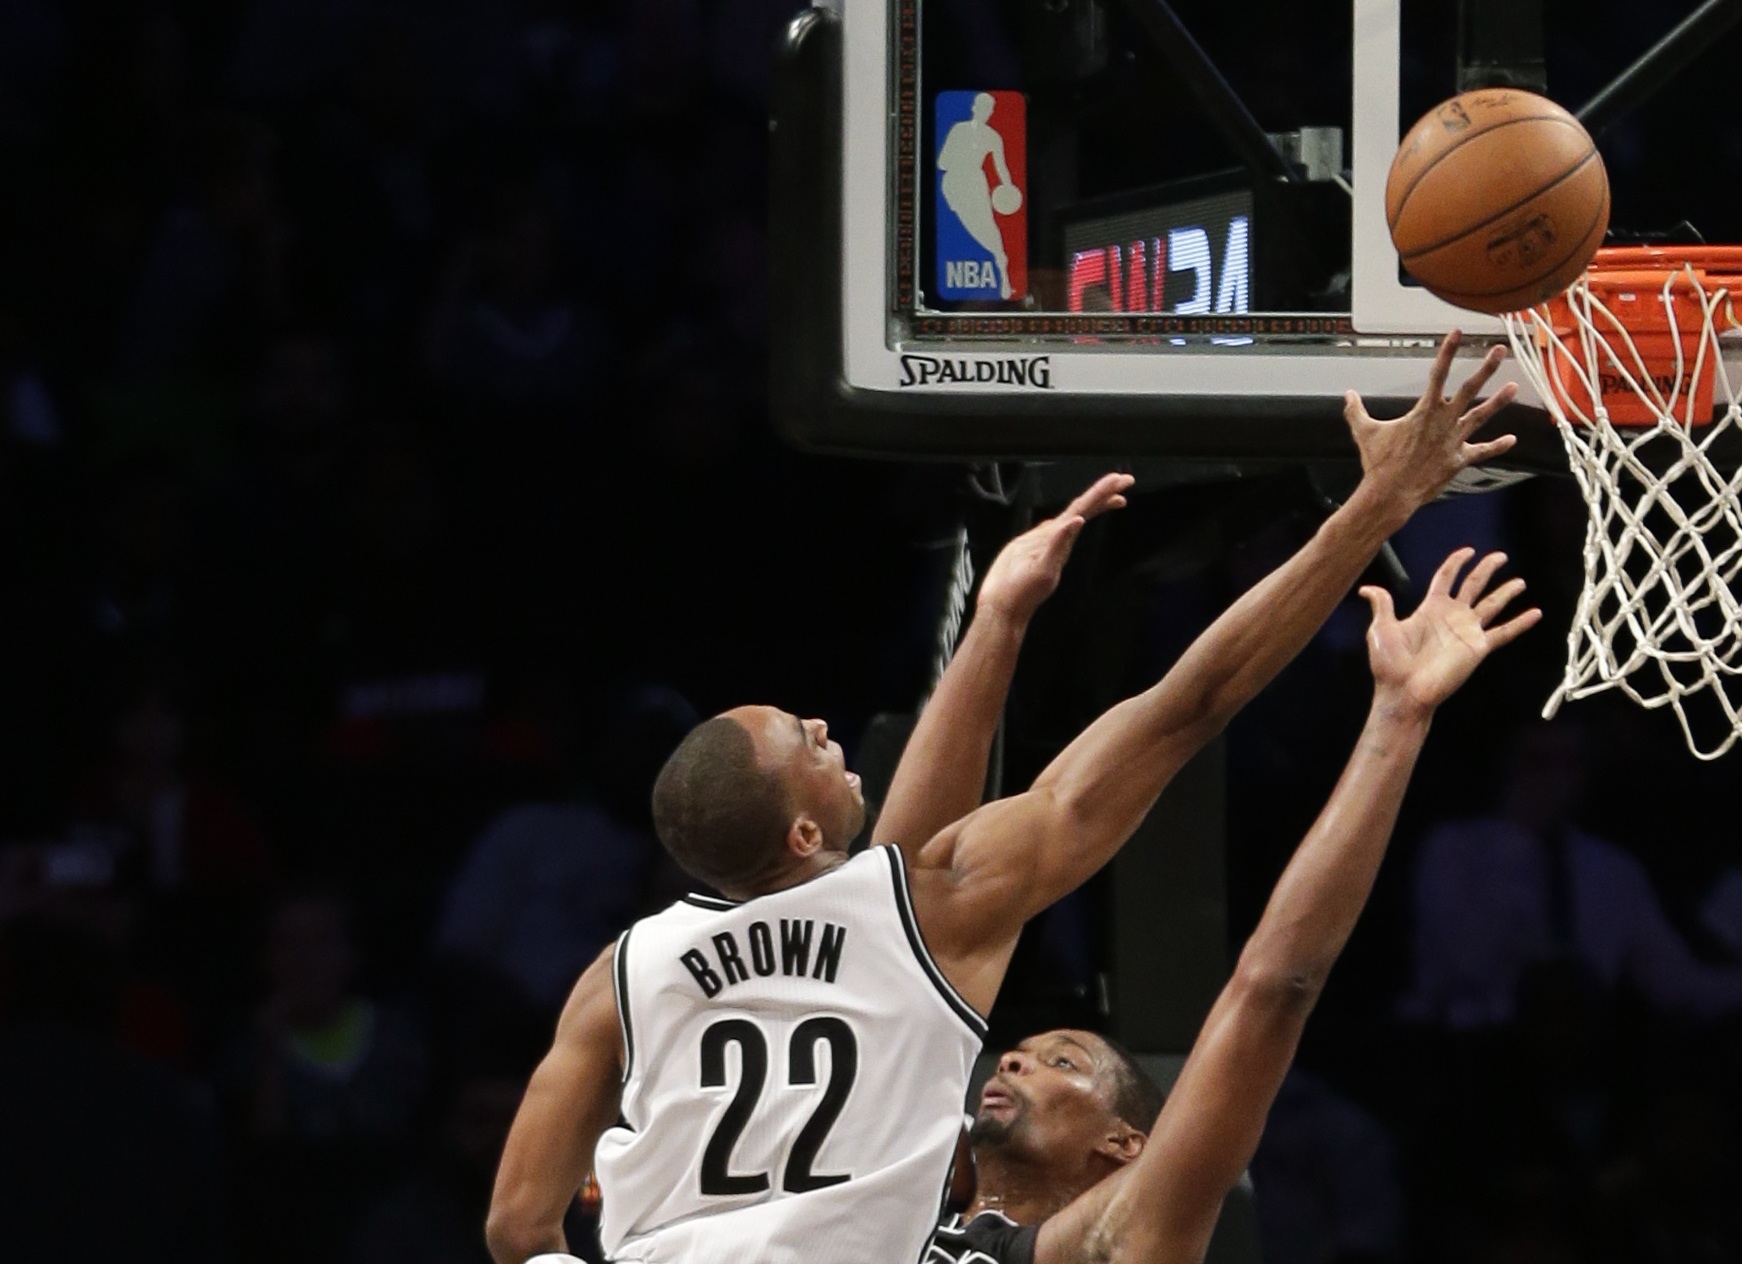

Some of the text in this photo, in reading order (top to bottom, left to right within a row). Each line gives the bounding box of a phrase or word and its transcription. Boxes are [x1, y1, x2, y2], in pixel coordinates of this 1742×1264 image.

[945, 260, 998, 289] NBA
[900, 354, 1051, 389] SPALDING
[679, 918, 847, 999] BROWN
[700, 1016, 858, 1196] 22
